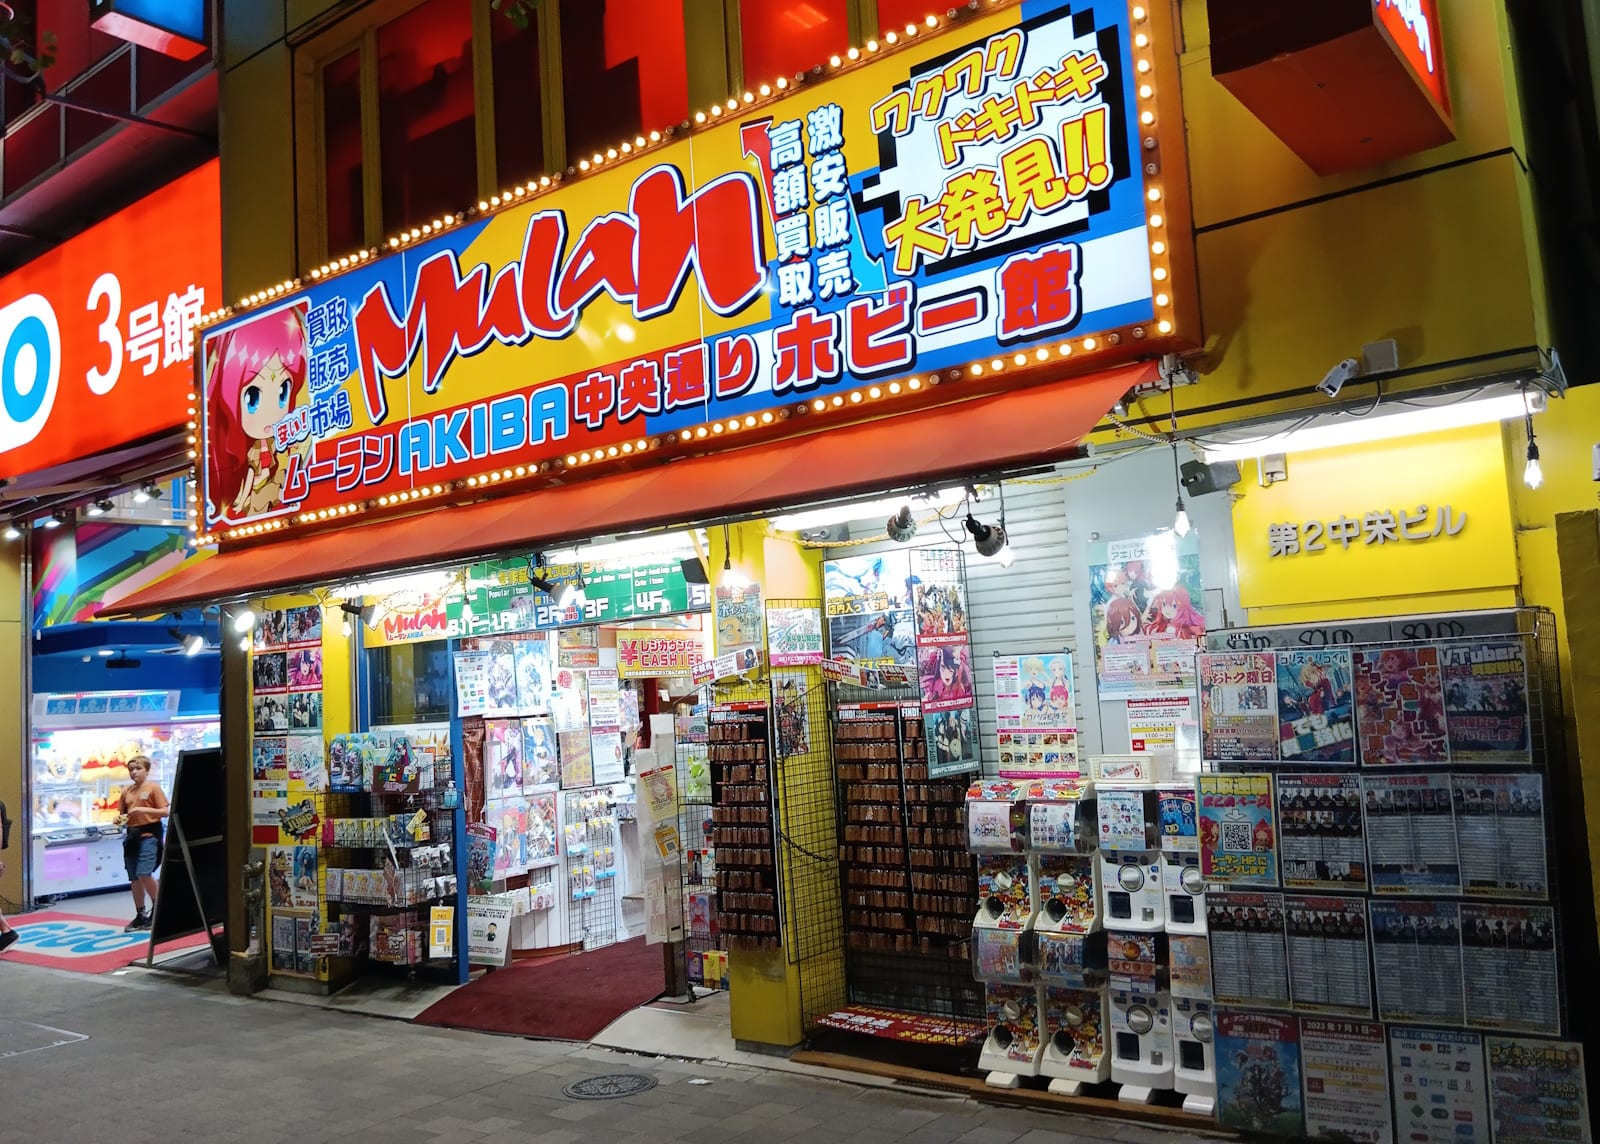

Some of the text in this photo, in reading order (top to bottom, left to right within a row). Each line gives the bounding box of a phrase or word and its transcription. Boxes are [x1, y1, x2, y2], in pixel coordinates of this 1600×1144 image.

[871, 28, 1025, 135] ワクワク
[937, 50, 1108, 165] ドキドキ
[768, 118, 815, 308] 高額買取
[806, 102, 857, 302] 激安販売
[352, 164, 768, 424] Mulan
[86, 272, 205, 396] 3号館
[306, 296, 350, 347] 買取
[281, 243, 1081, 502] ムーラン AKIBA 中央通り ホビー館
[308, 345, 351, 394] 販売
[311, 390, 352, 437] 市場
[1268, 503, 1467, 558] 第2中栄ビル
[383, 608, 447, 641] Mulan
[537, 605, 559, 625] 2F
[584, 597, 609, 619] 3F
[636, 590, 663, 613] 4F
[640, 639, 703, 653] レジカウンター
[641, 653, 703, 668] CASHIER
[1441, 645, 1522, 667] VTuber
[288, 813, 314, 833] JUMP
